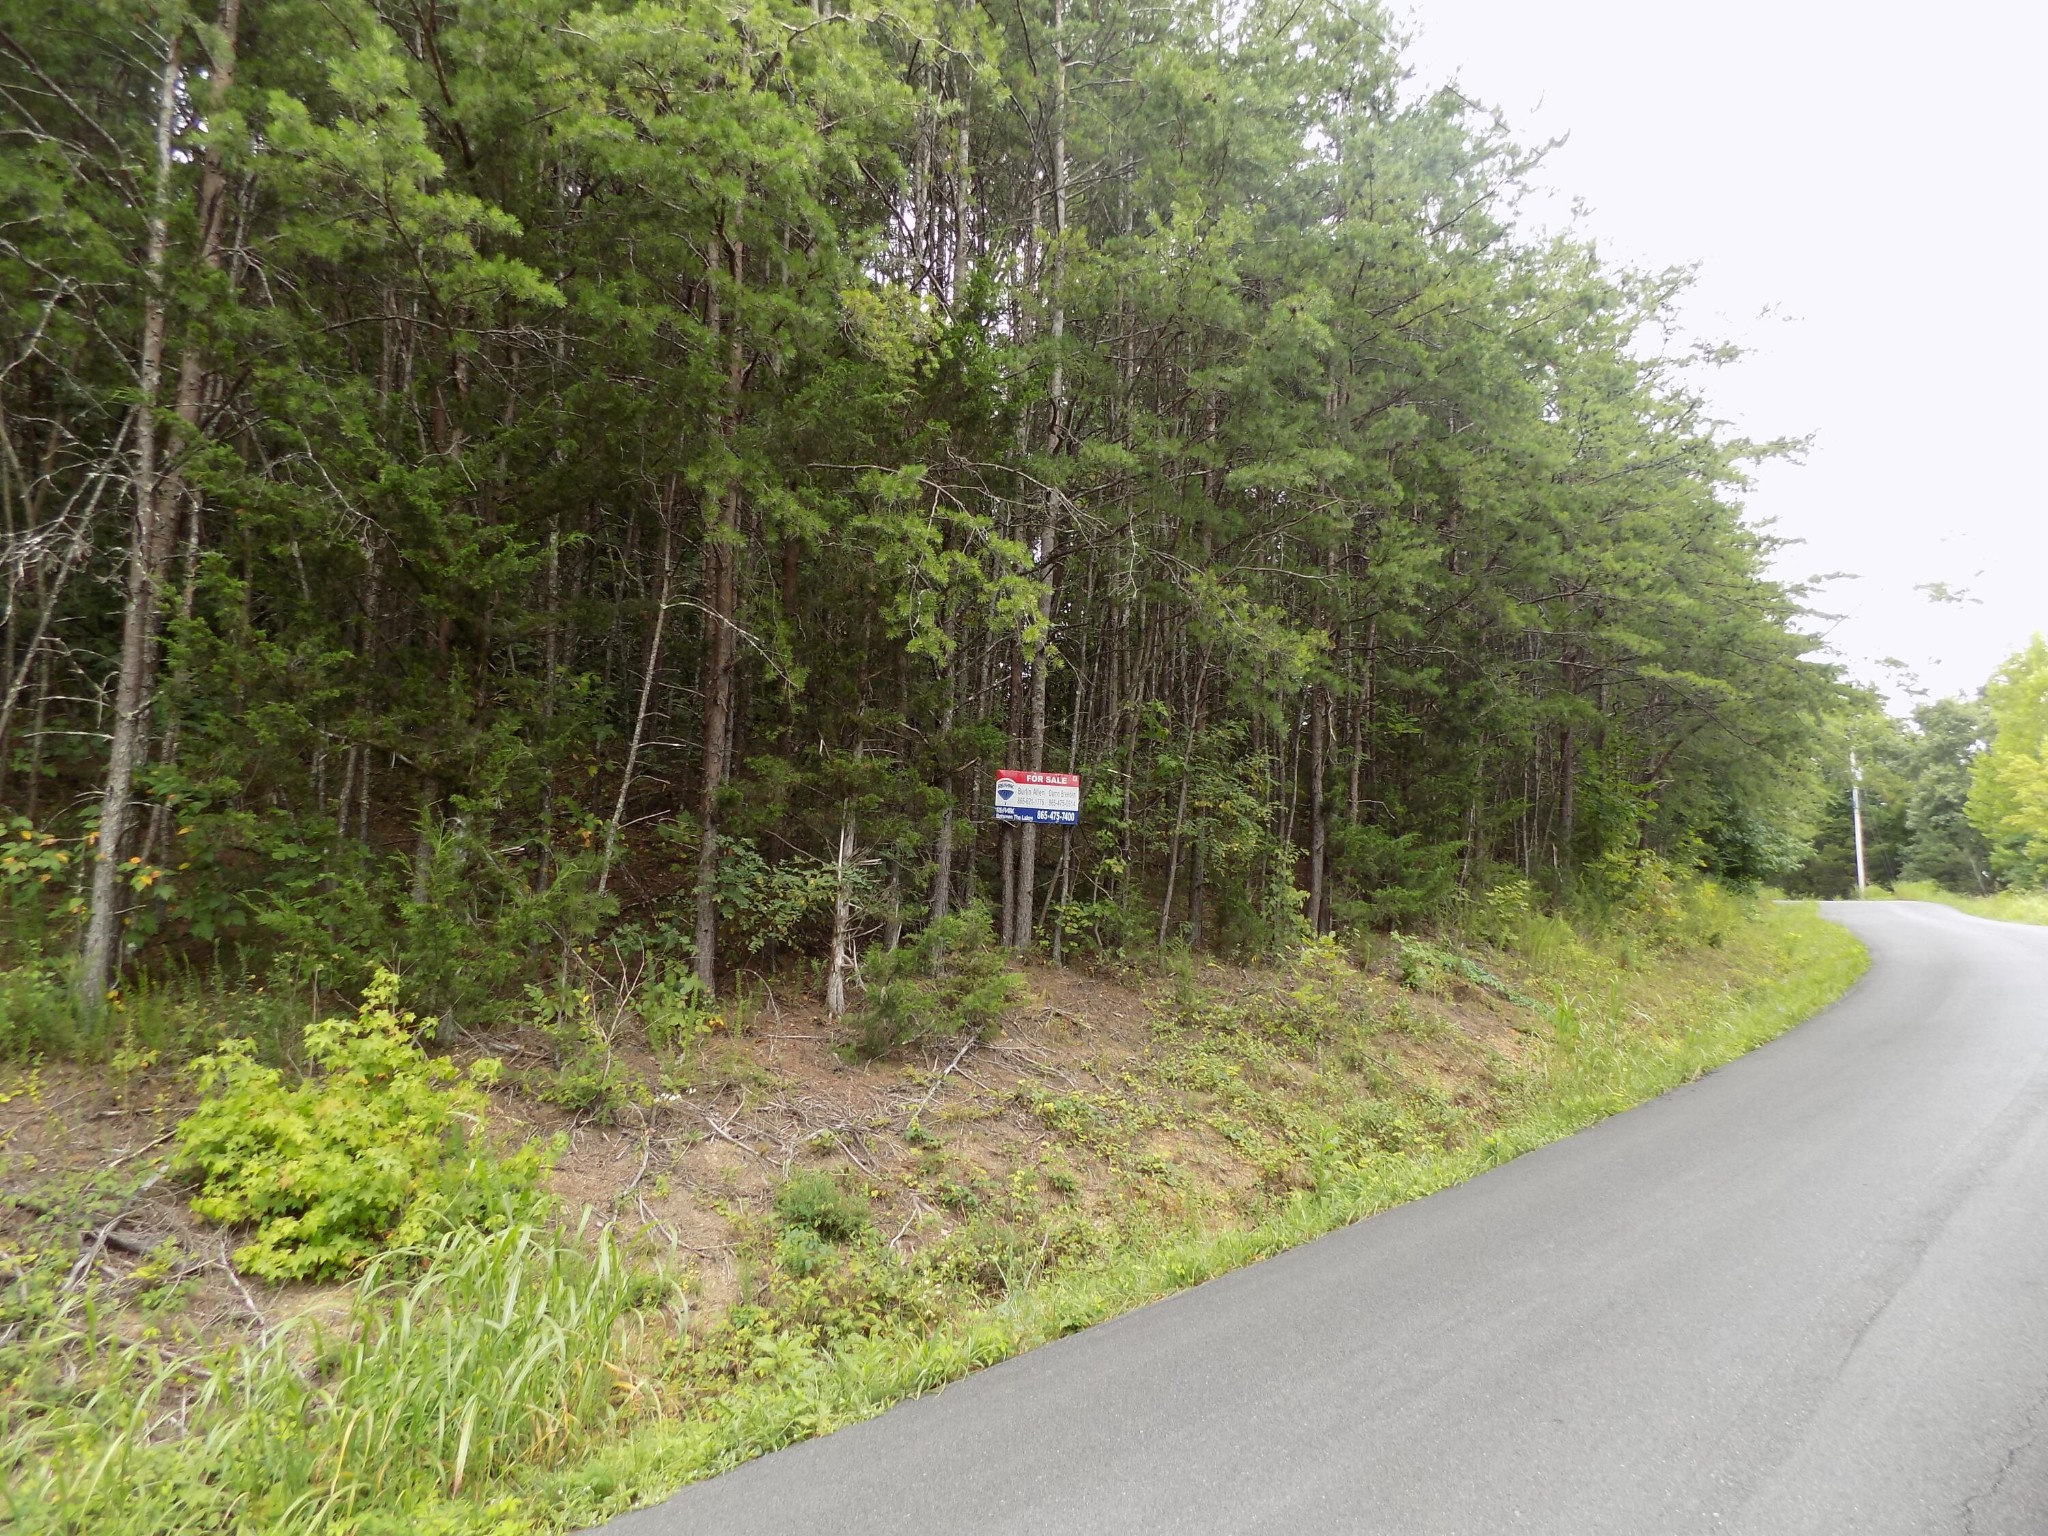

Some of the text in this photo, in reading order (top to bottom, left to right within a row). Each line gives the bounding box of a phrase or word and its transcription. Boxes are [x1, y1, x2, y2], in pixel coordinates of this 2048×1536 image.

[1027, 775, 1067, 784] FOR SALE
[1036, 810, 1075, 822] 865-475-7400
